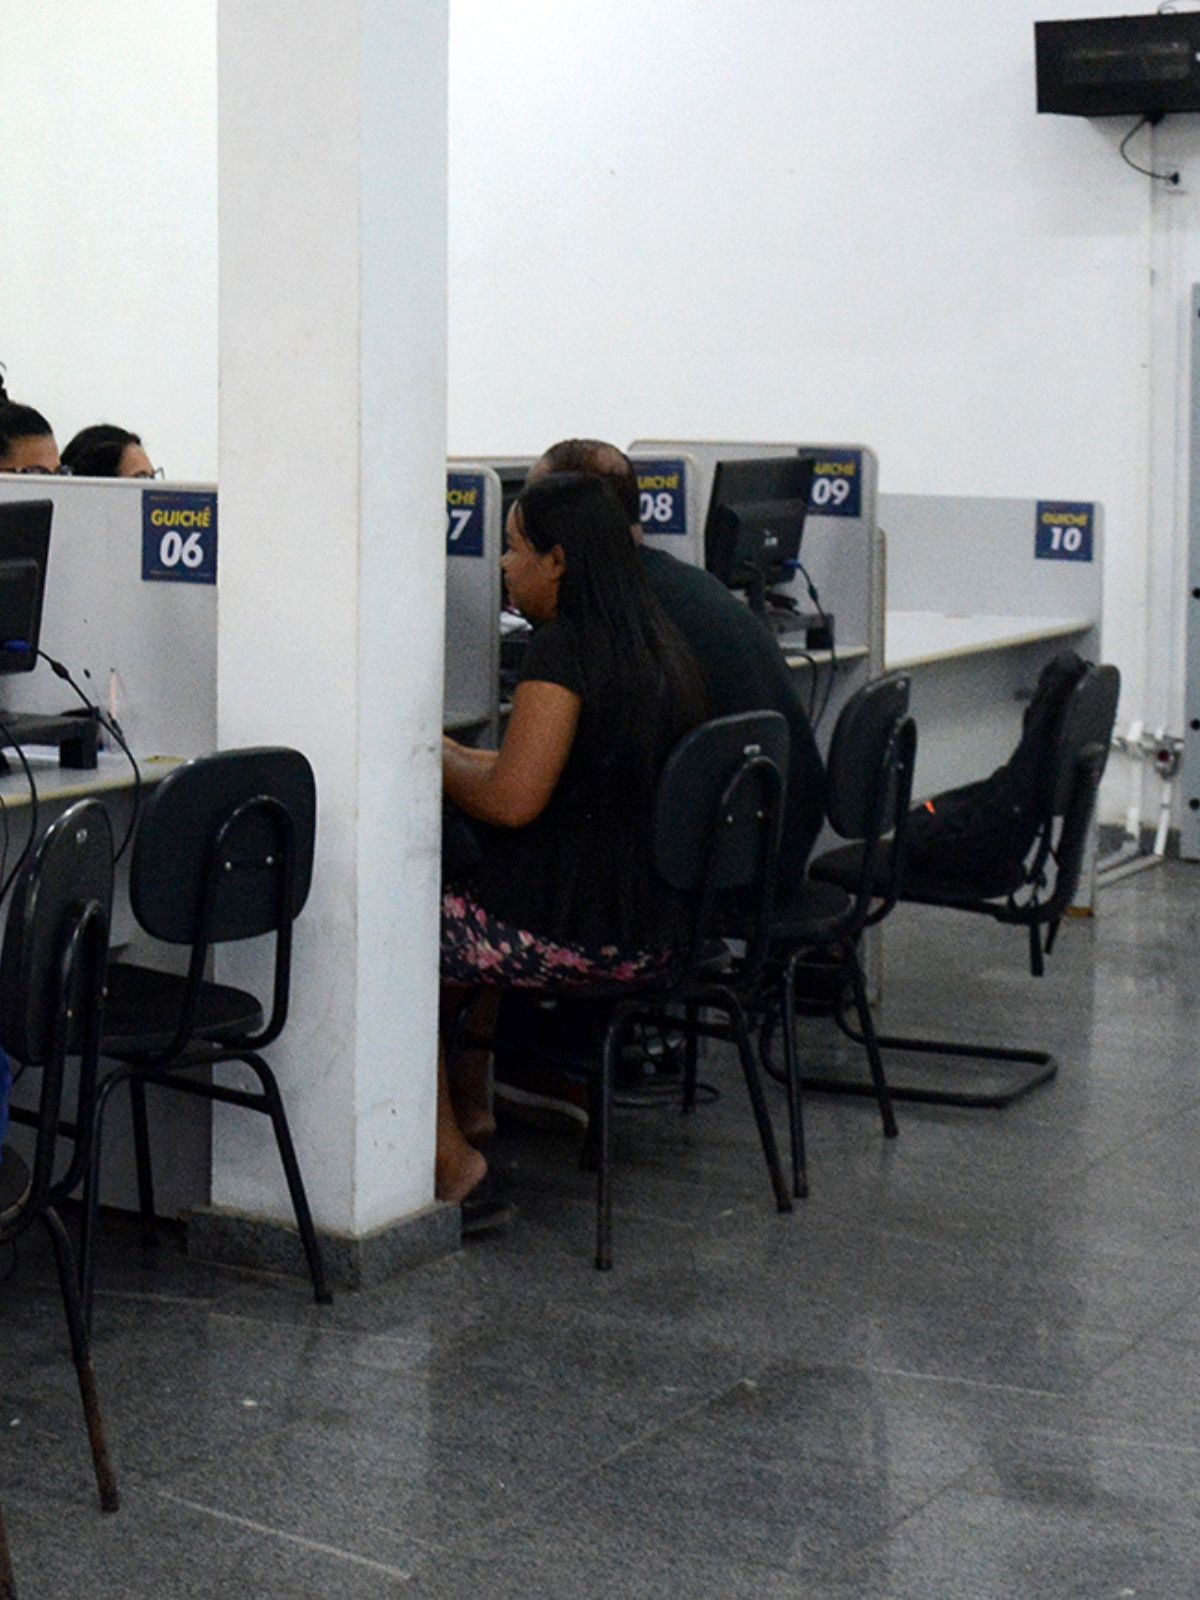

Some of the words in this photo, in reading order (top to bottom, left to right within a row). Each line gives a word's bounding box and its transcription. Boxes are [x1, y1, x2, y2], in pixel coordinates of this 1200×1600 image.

[638, 472, 679, 489] UICHÊ
[814, 461, 856, 476] UICHÊ
[812, 478, 850, 505] 09
[151, 506, 211, 528] GUICHÊ
[640, 493, 673, 522] 08
[450, 509, 473, 540] 7
[160, 531, 204, 567] 06
[1051, 527, 1082, 551] 10
